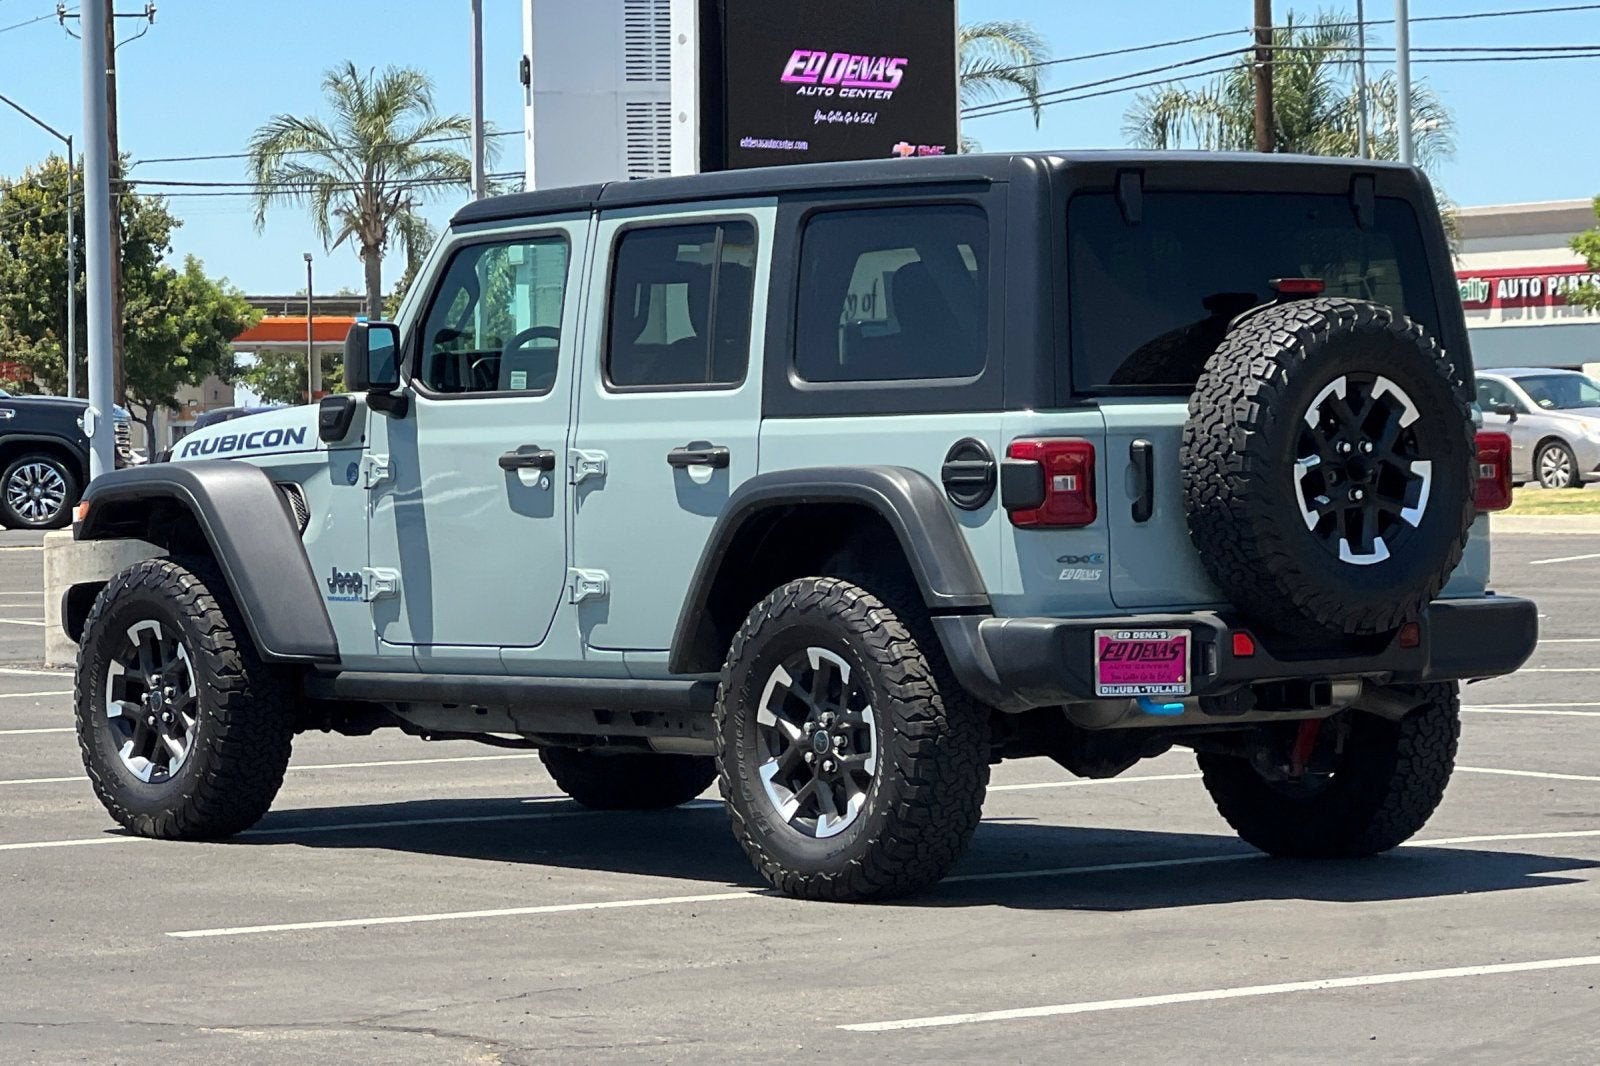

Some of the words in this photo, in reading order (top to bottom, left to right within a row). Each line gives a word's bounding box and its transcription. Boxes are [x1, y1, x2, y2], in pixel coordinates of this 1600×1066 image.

[781, 50, 827, 84] ED
[823, 53, 908, 89] DENA'S
[797, 86, 834, 97] AUTO
[839, 88, 893, 100] CENTER
[1457, 277, 1490, 303] eilly
[1497, 278, 1541, 299] AUTO
[181, 426, 307, 458] RUBICON
[327, 566, 363, 594] Jeep
[1118, 631, 1131, 639] ED
[1100, 642, 1130, 661] ED
[1145, 685, 1185, 693] TULARE
